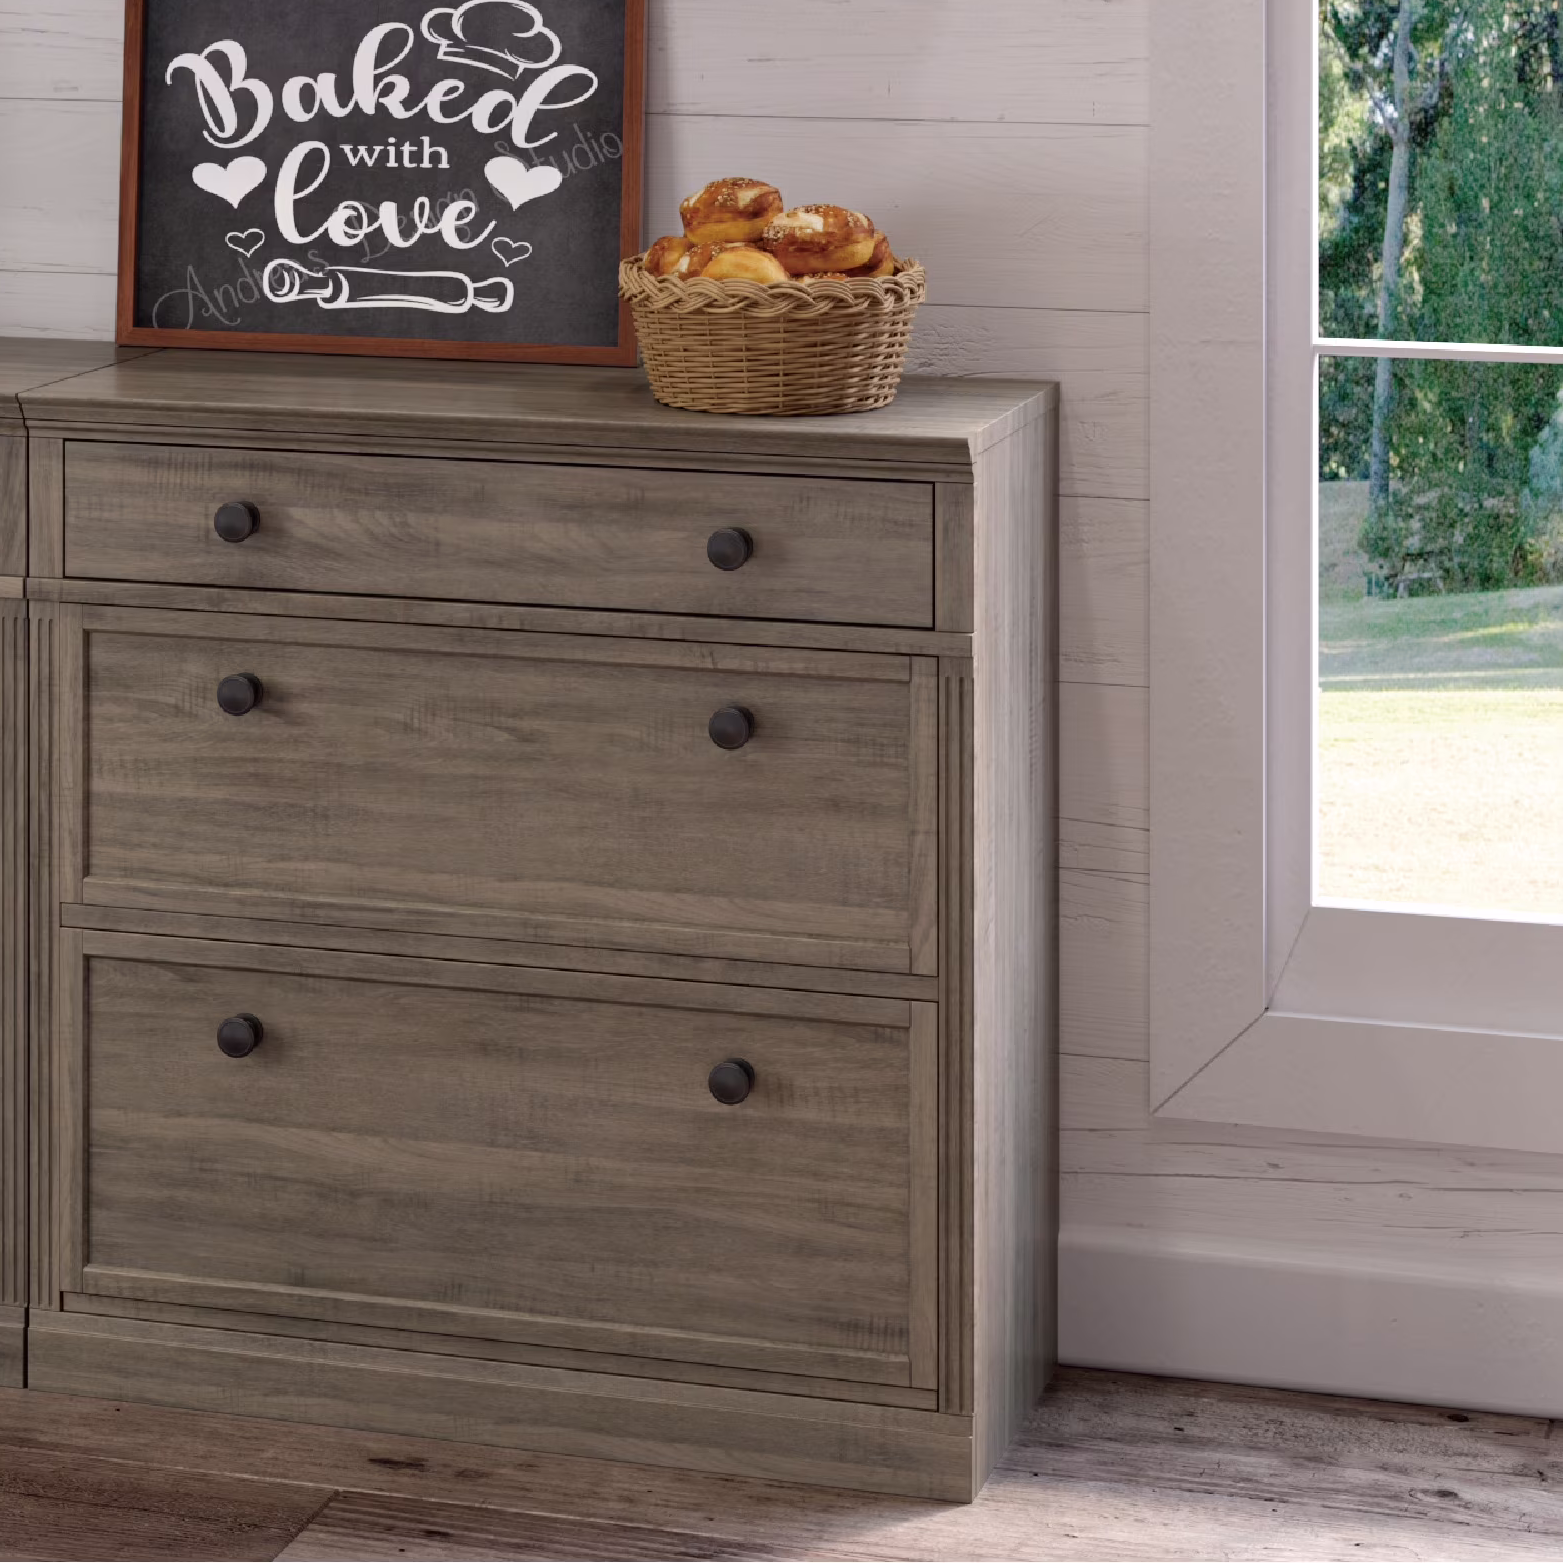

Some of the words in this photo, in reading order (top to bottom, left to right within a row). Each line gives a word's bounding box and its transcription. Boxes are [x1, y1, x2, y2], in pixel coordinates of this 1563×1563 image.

[164, 22, 599, 149] Baked
[274, 140, 498, 250] love
[339, 135, 450, 169] with
